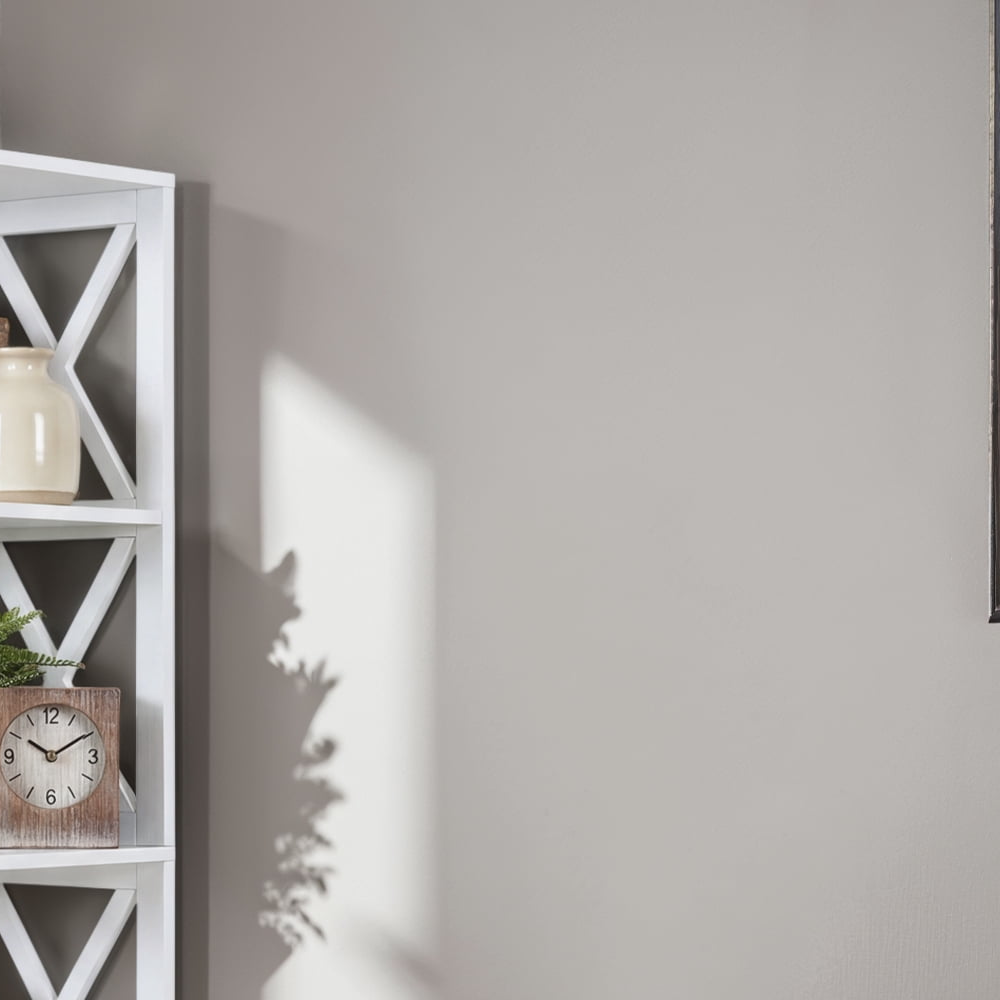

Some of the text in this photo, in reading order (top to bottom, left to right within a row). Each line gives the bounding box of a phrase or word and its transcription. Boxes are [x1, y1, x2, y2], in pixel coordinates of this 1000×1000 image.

[43, 707, 59, 724] 12
[4, 748, 15, 764] 9
[88, 748, 98, 764] 3
[46, 789, 56, 805] 6
